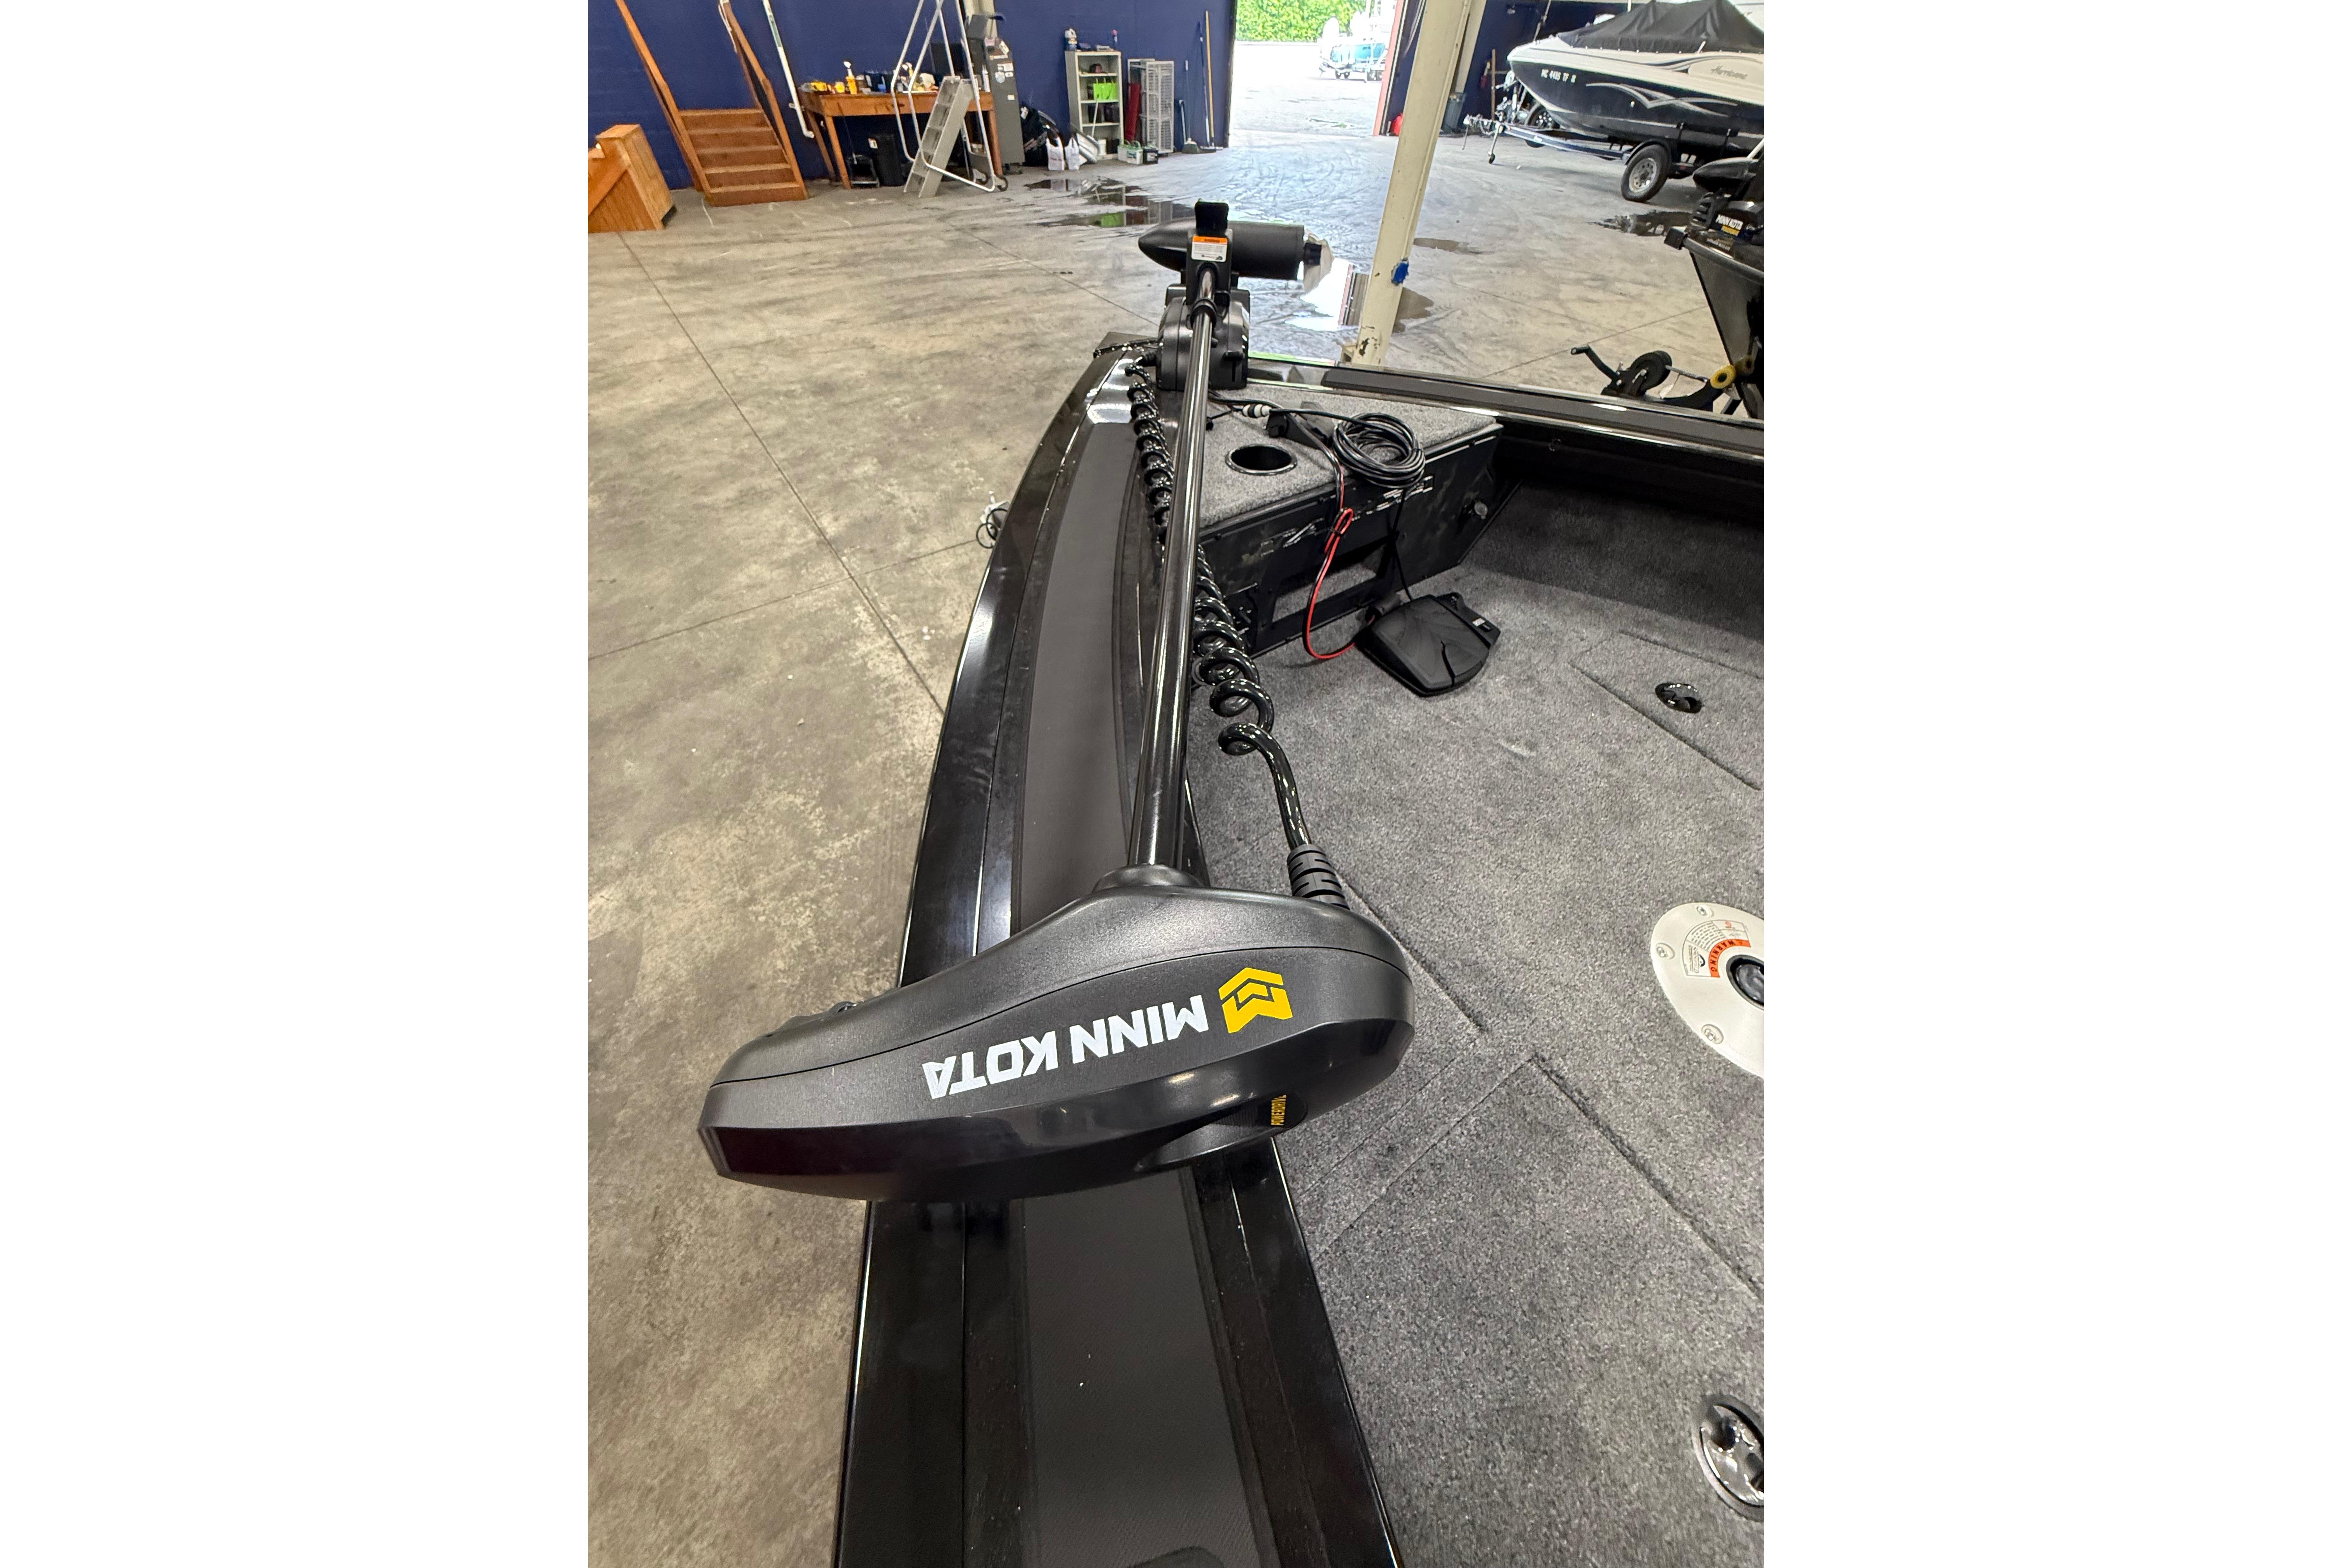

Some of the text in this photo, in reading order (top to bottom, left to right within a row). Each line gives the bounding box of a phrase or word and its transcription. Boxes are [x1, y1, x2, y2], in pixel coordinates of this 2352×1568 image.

[1710, 940, 1735, 973] WARNING
[922, 995, 1209, 1099] MINN KOTA
